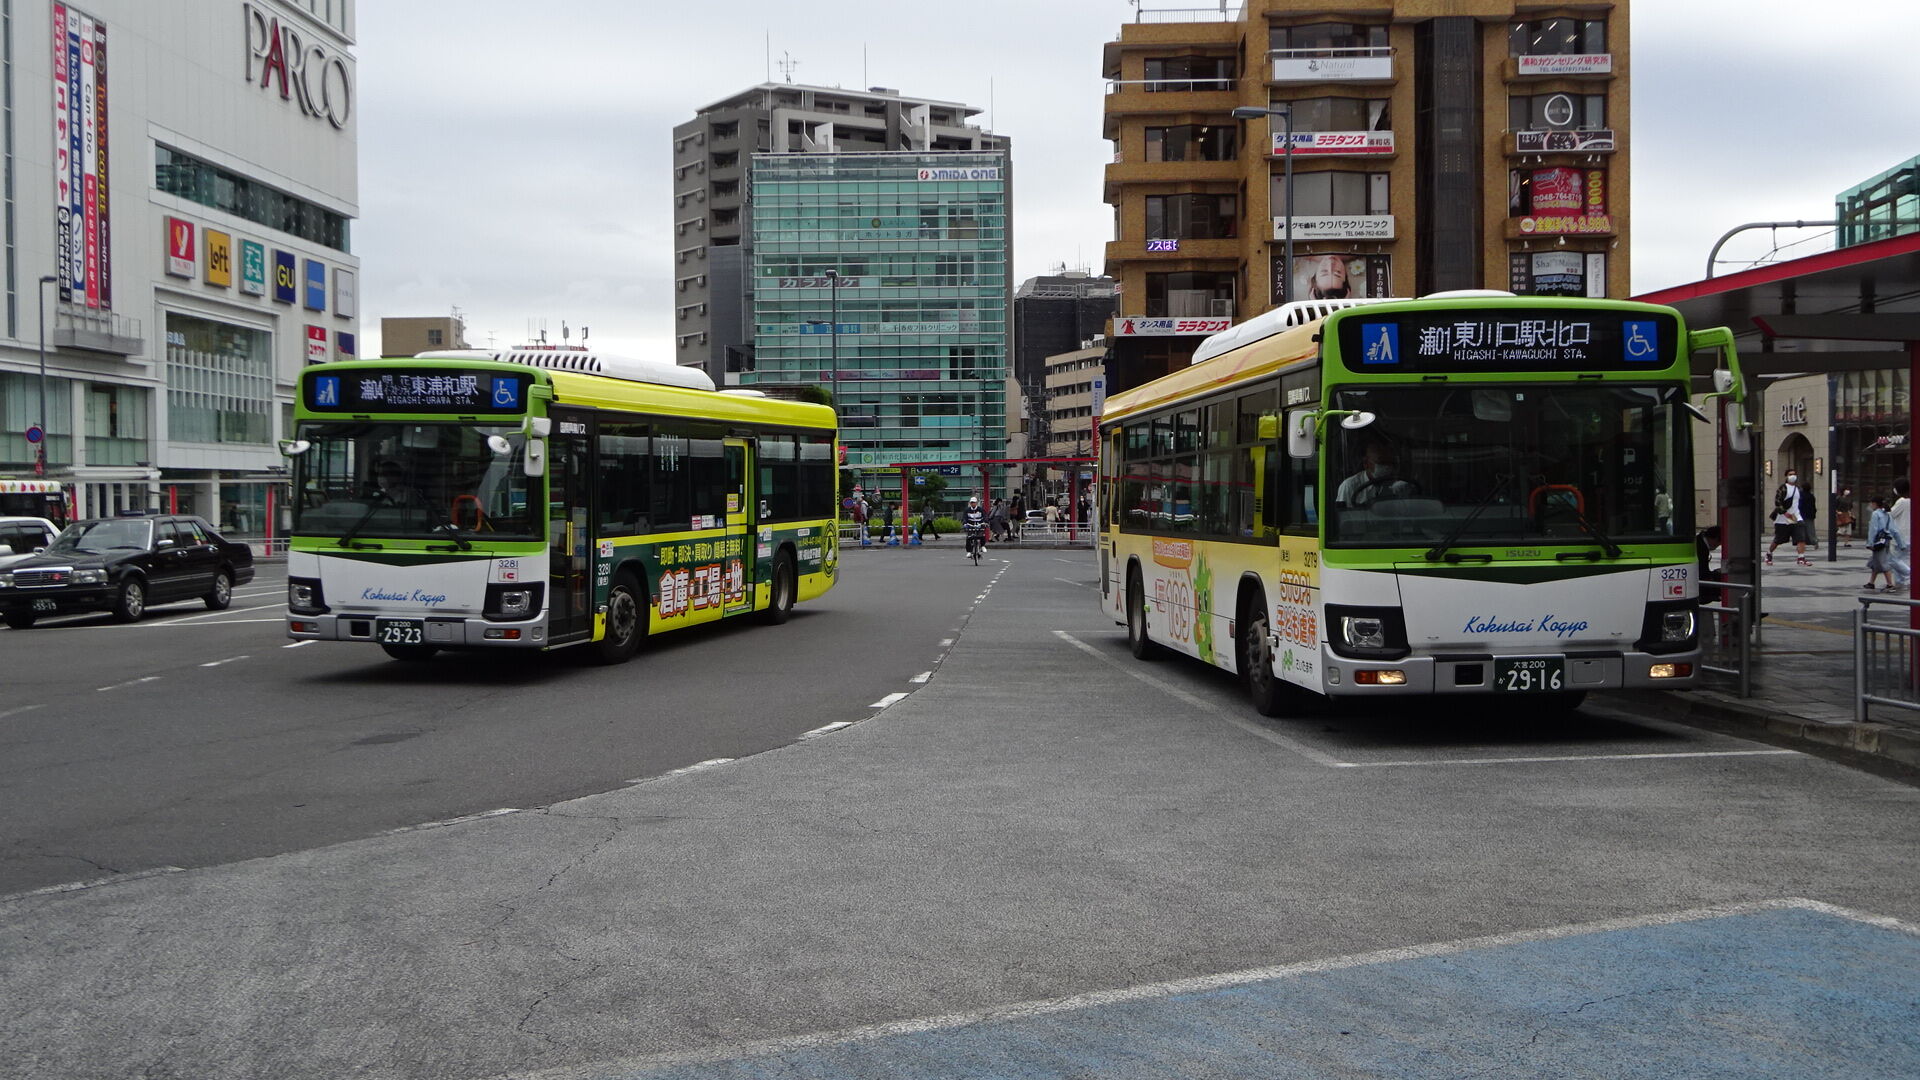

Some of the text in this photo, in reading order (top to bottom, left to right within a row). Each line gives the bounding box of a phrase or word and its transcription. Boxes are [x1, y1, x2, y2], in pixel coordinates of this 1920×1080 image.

[243, 2, 351, 130] PARCO
[1320, 60, 1355, 69] Natural
[1521, 57, 1608, 66] 浦和カウンセリング研究所
[58, 86, 67, 202] ユザワヤ
[1316, 135, 1366, 145] ララダンス
[1368, 138, 1391, 146] 浦和店
[971, 169, 996, 180] ONE
[1319, 220, 1388, 230] クワバラクリニック
[74, 221, 82, 273] ノジマ
[210, 243, 229, 273] Loft
[277, 264, 294, 288] GU
[783, 278, 857, 288] カラオケ
[1140, 320, 1230, 332] ダンス用品 ララダンス
[1454, 320, 1591, 348] 東川口駅北口
[1454, 347, 1587, 361] HIGASHI-KAWAGUCHI STA.
[410, 375, 479, 396] 東浦和駅
[386, 396, 475, 405] HIGASHI-URAWA STA.
[498, 560, 519, 568] 3281
[1304, 551, 1318, 568] 3279
[598, 563, 611, 576] 3281
[1661, 568, 1688, 580] 3279
[1280, 569, 1312, 606] STOP!
[361, 587, 447, 607] Kokusai Kogyo
[1166, 578, 1190, 643] 189
[1463, 614, 1589, 638] Kokusai Kogyo
[384, 627, 421, 643] 29-23
[1507, 669, 1561, 690] 29-16
